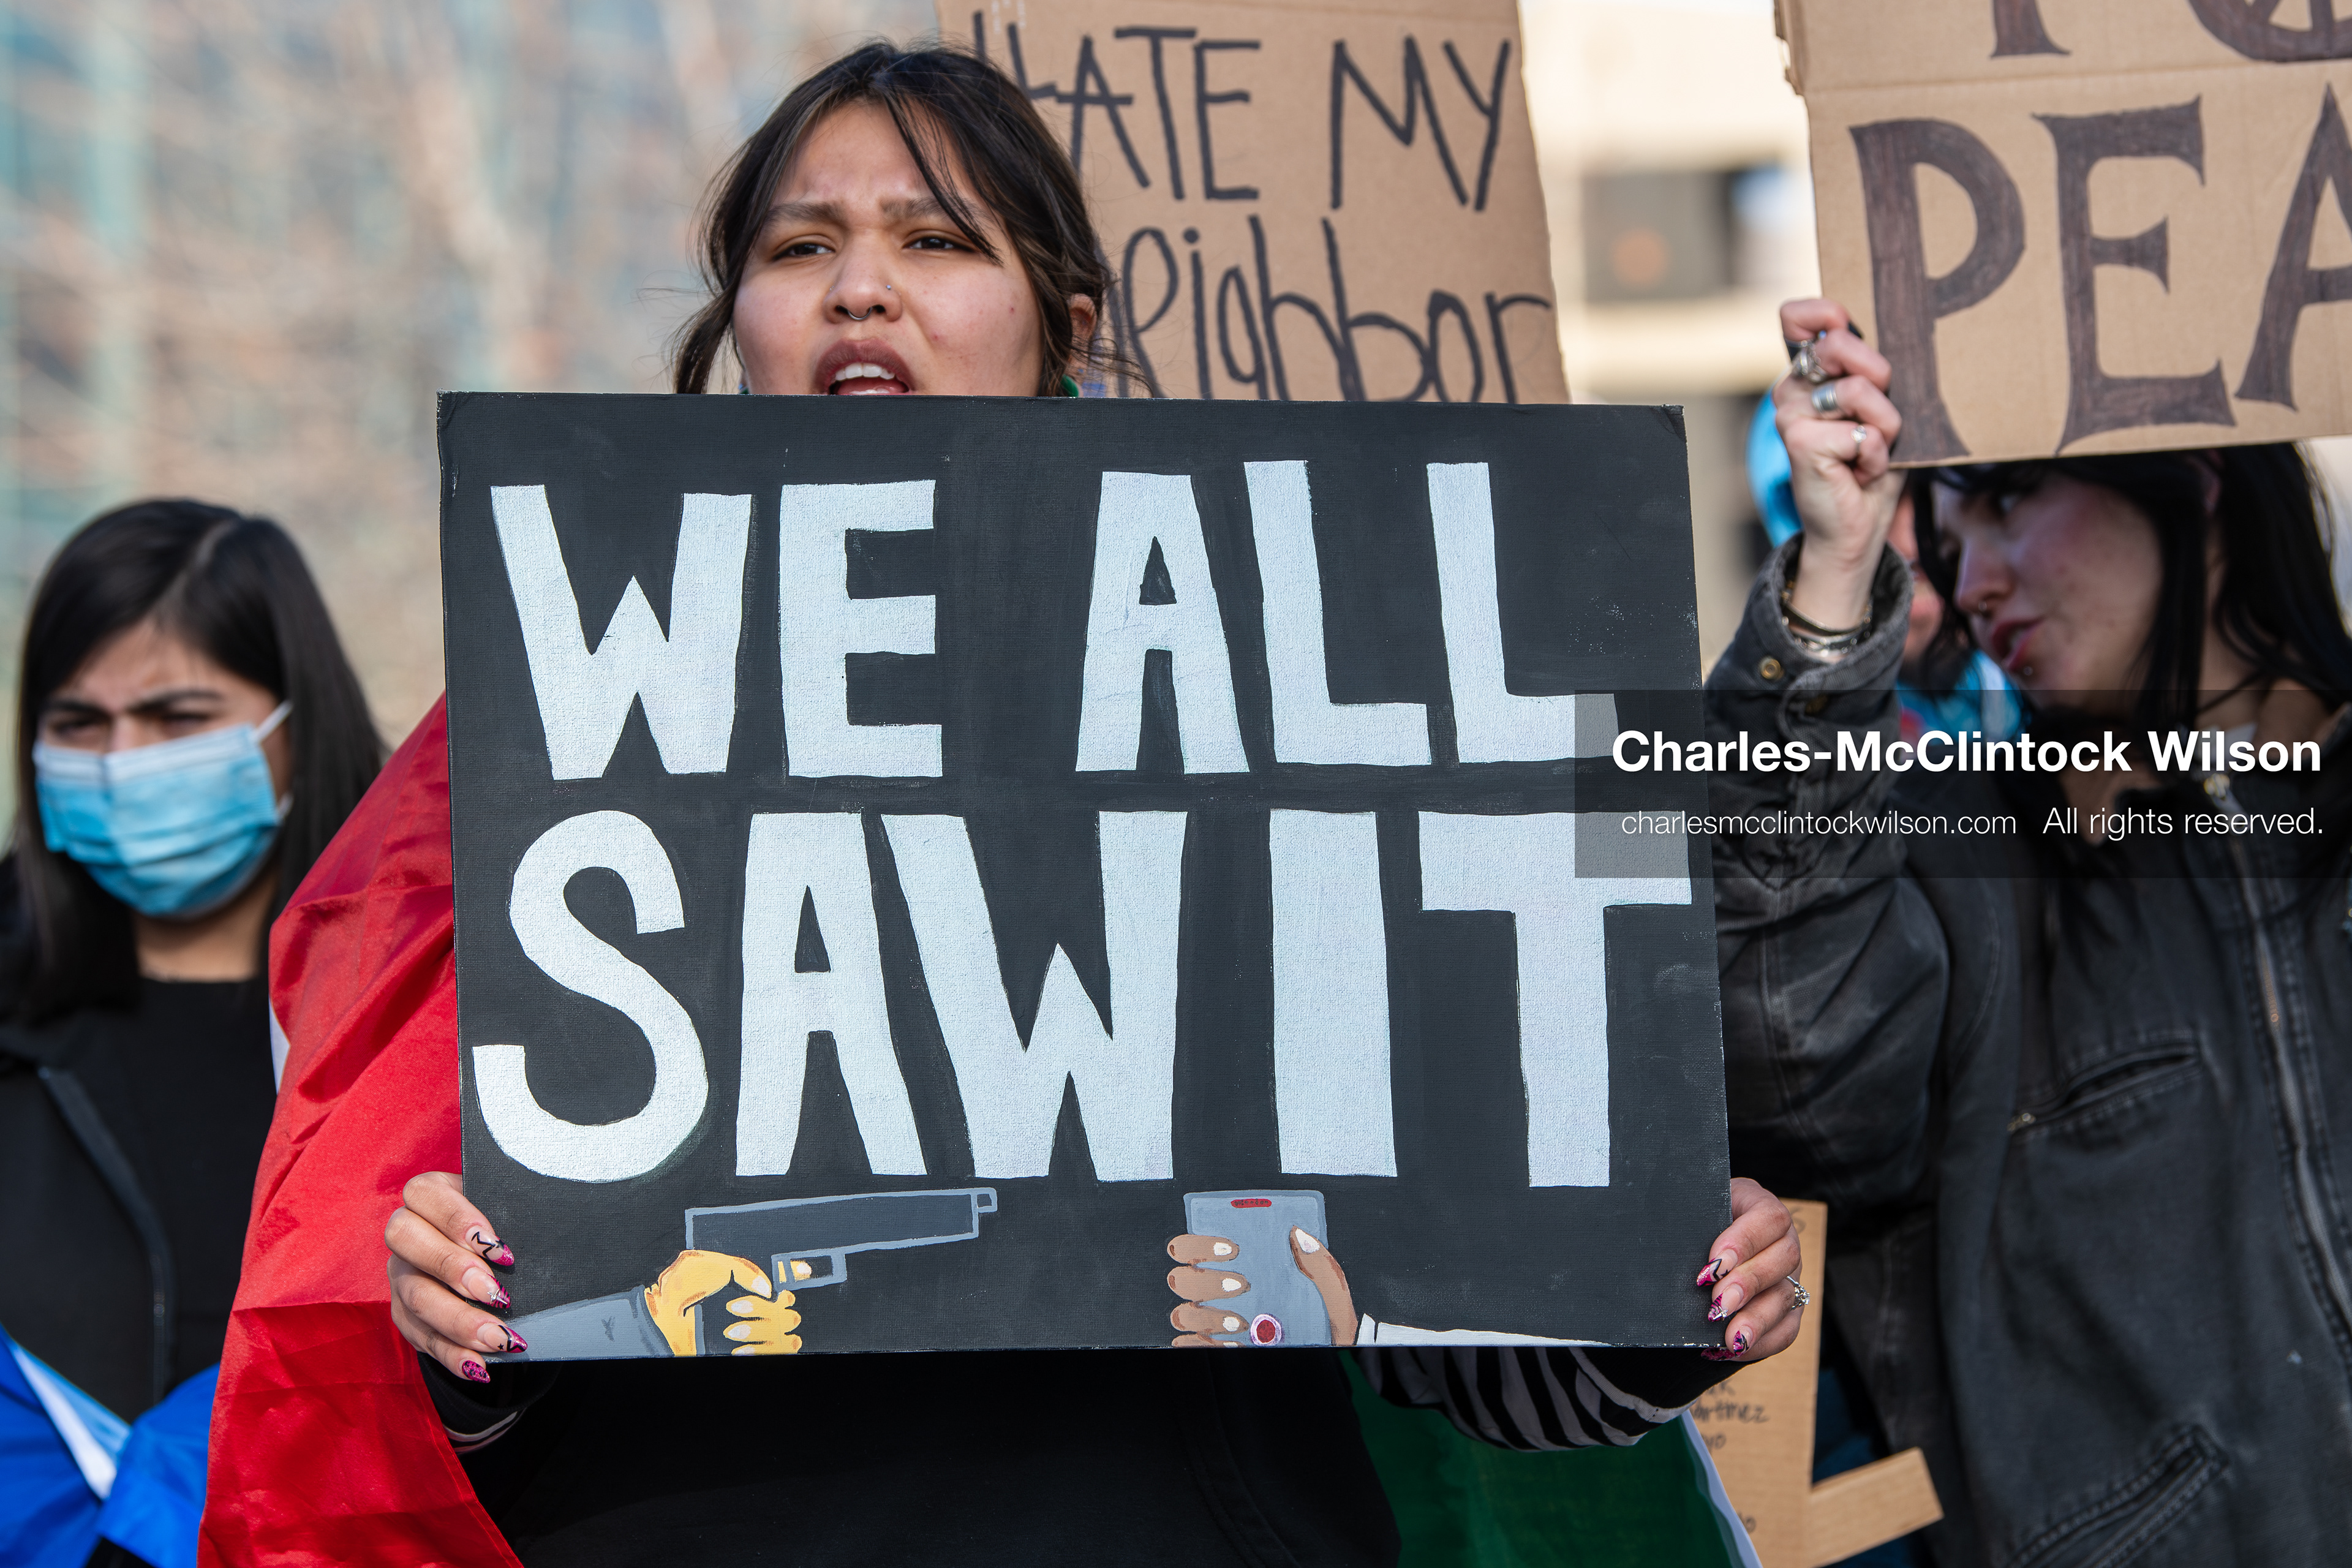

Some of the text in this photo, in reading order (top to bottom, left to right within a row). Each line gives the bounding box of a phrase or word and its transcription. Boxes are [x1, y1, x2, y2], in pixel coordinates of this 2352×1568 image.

[1330, 34, 1512, 212] MY
[491, 461, 1619, 780] WE ALL
[472, 809, 1692, 1186] SAW IT
